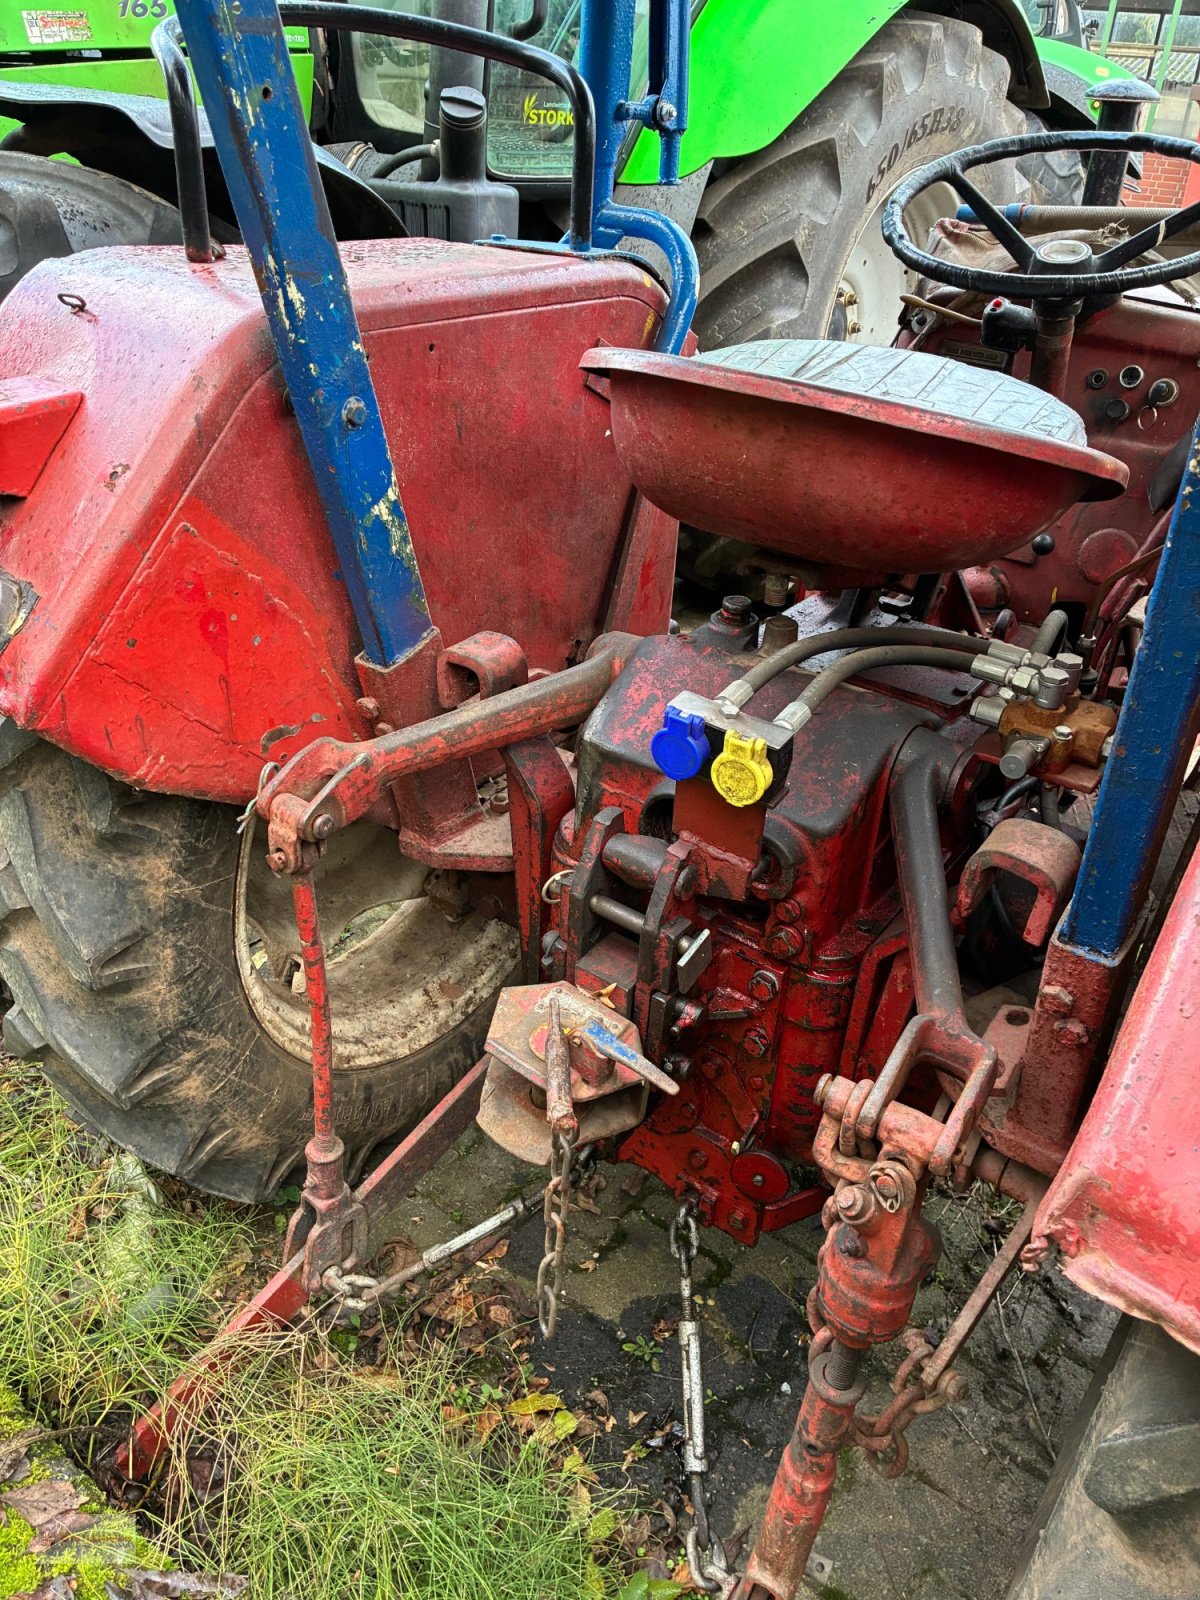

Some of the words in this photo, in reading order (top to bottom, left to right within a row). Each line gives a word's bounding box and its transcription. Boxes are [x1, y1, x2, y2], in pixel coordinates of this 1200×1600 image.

[117, 0, 169, 18] 165
[528, 109, 574, 126] STORK
[865, 106, 967, 204] 650/65R38
